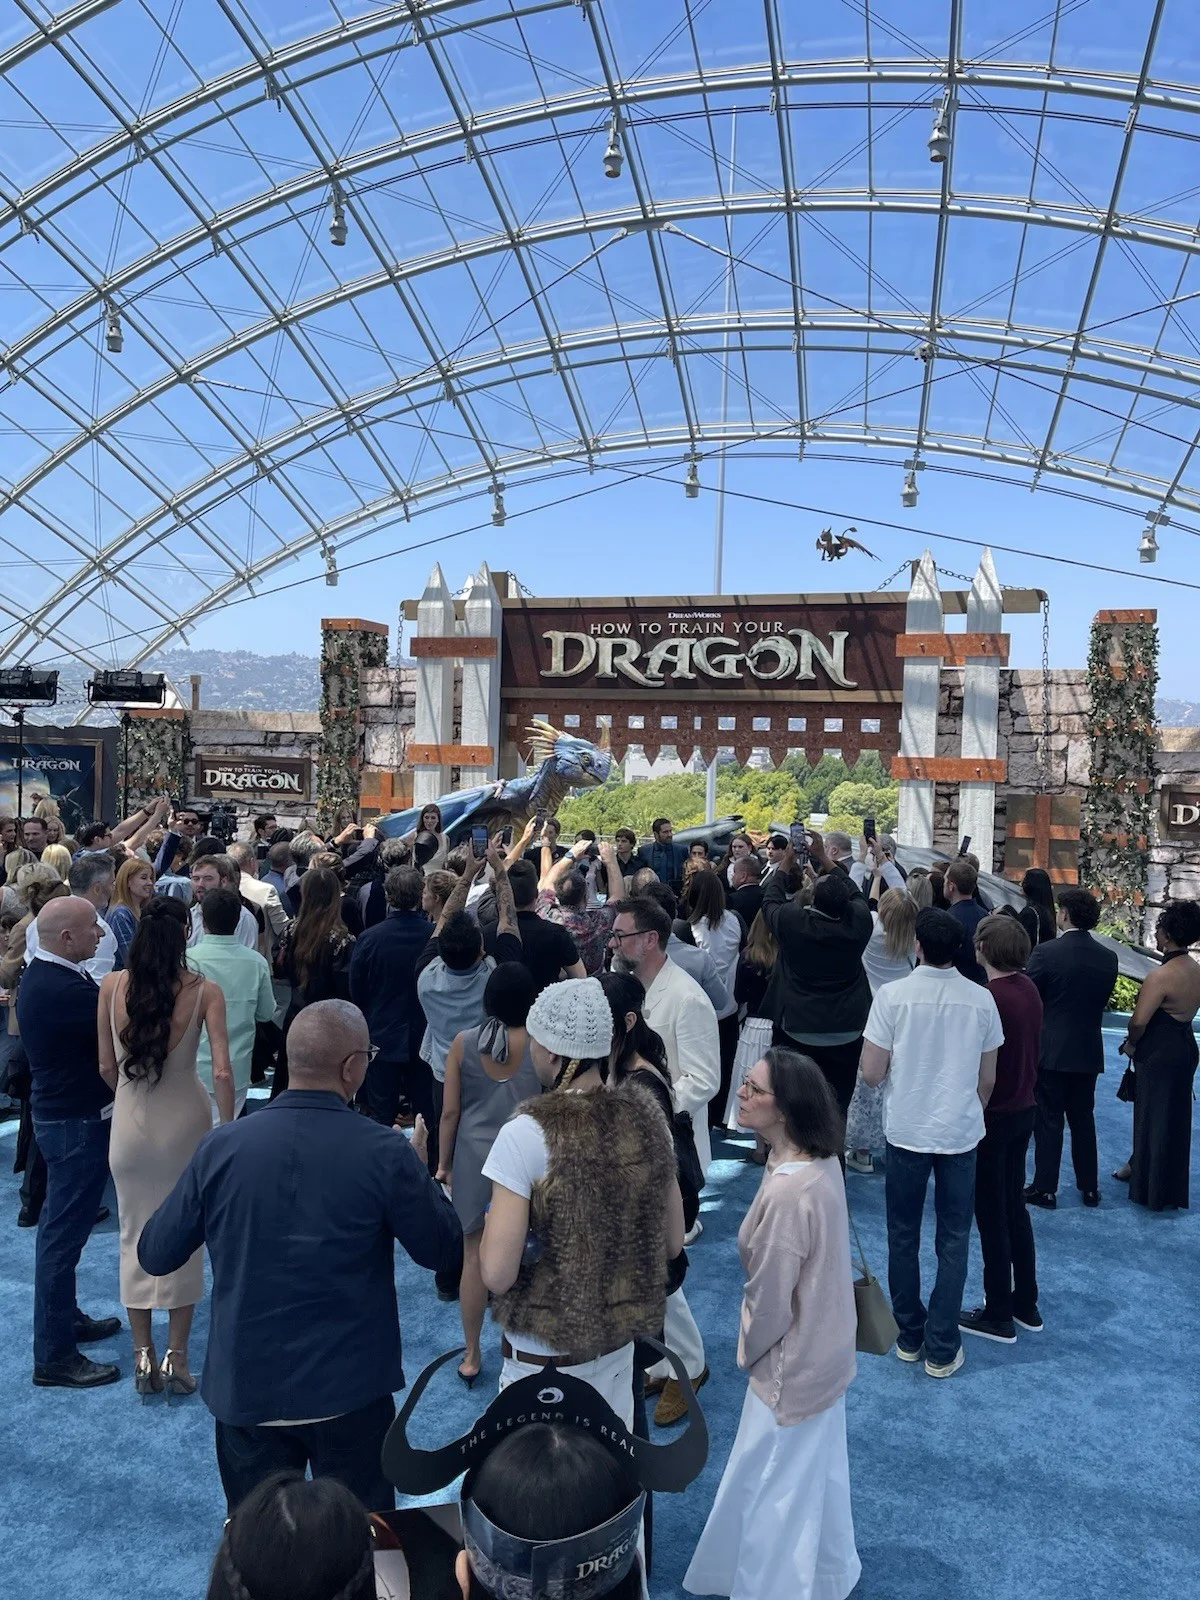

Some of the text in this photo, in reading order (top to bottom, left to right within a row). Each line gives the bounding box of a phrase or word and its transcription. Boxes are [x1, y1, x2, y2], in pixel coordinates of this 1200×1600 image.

[590, 621, 785, 635] HOW TO TRAIN YOUR
[540, 628, 858, 688] DRAGON
[11, 757, 82, 772] DRAGON
[202, 769, 302, 792] DRAGON
[1171, 804, 1200, 825] D
[460, 1412, 635, 1457] THE LEGEND IS REAL
